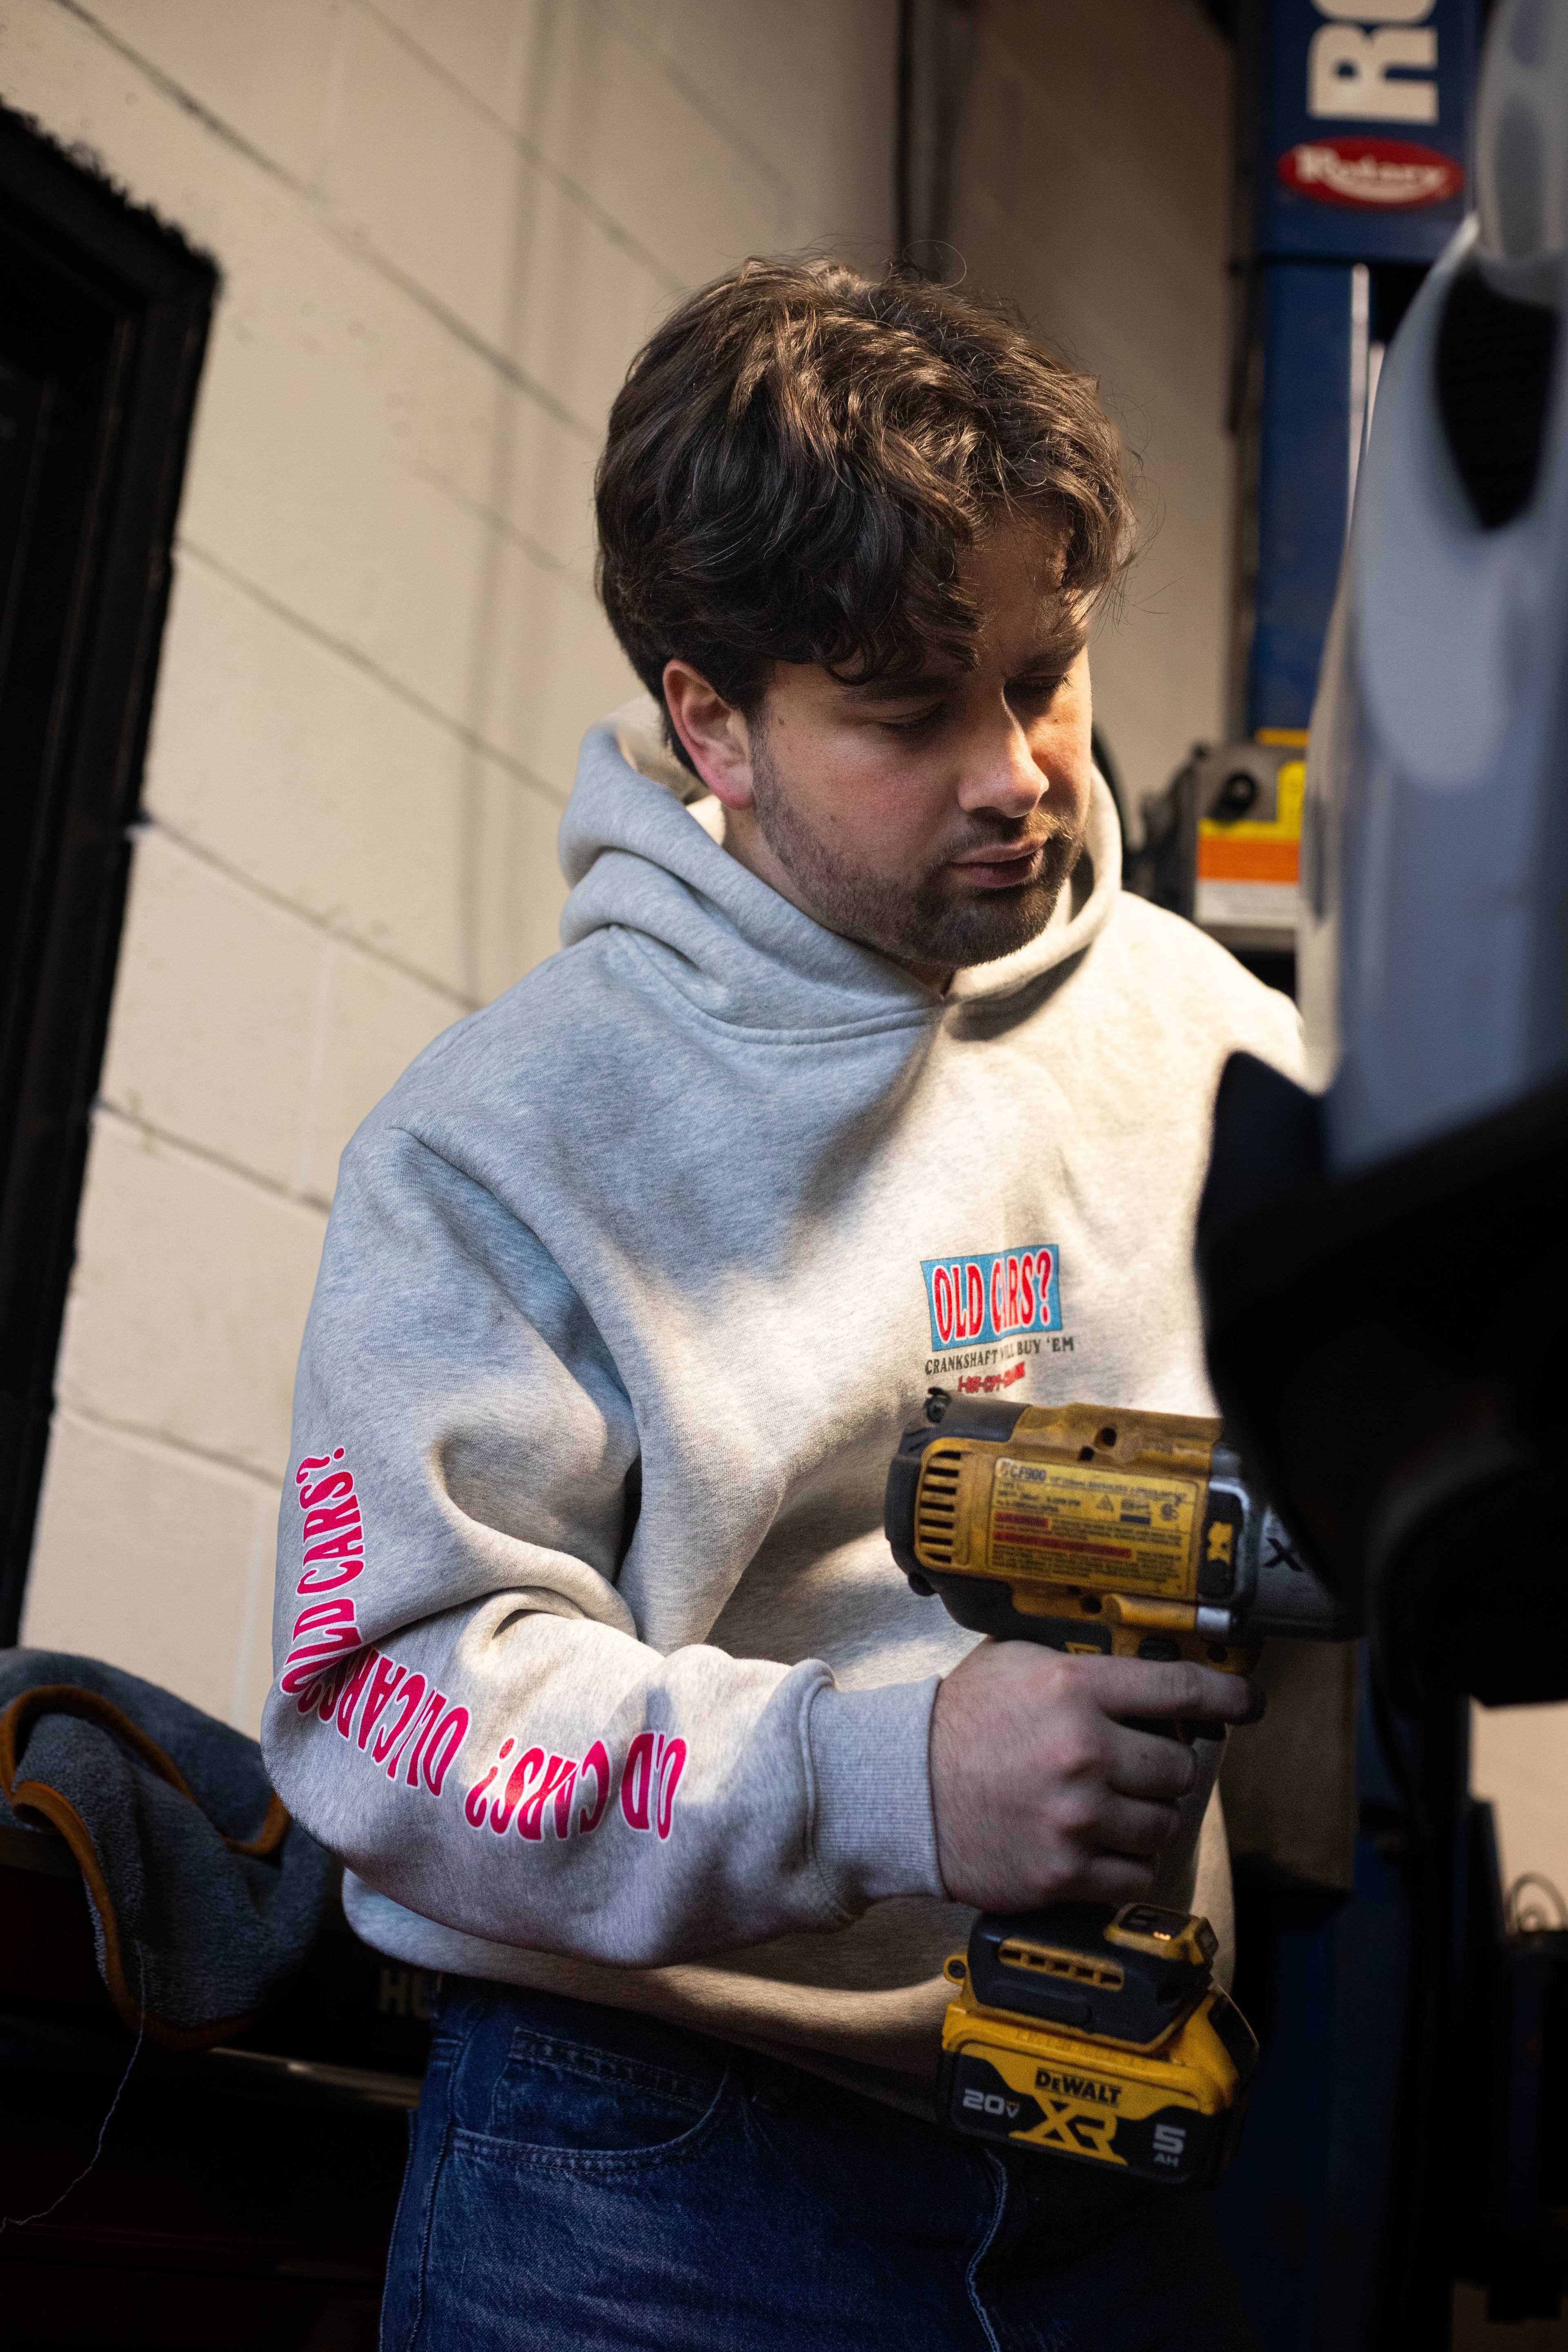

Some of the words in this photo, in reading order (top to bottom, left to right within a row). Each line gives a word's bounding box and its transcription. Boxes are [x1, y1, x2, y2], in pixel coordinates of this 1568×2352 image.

[932, 1263, 985, 1344] OLD
[924, 1348, 998, 1375] CRANKSHAFT
[1017, 1339, 1041, 1355] BUY
[295, 1447, 365, 1596] CARS?
[620, 1731, 688, 1841] OD
[1152, 2124, 1187, 2155] 5
